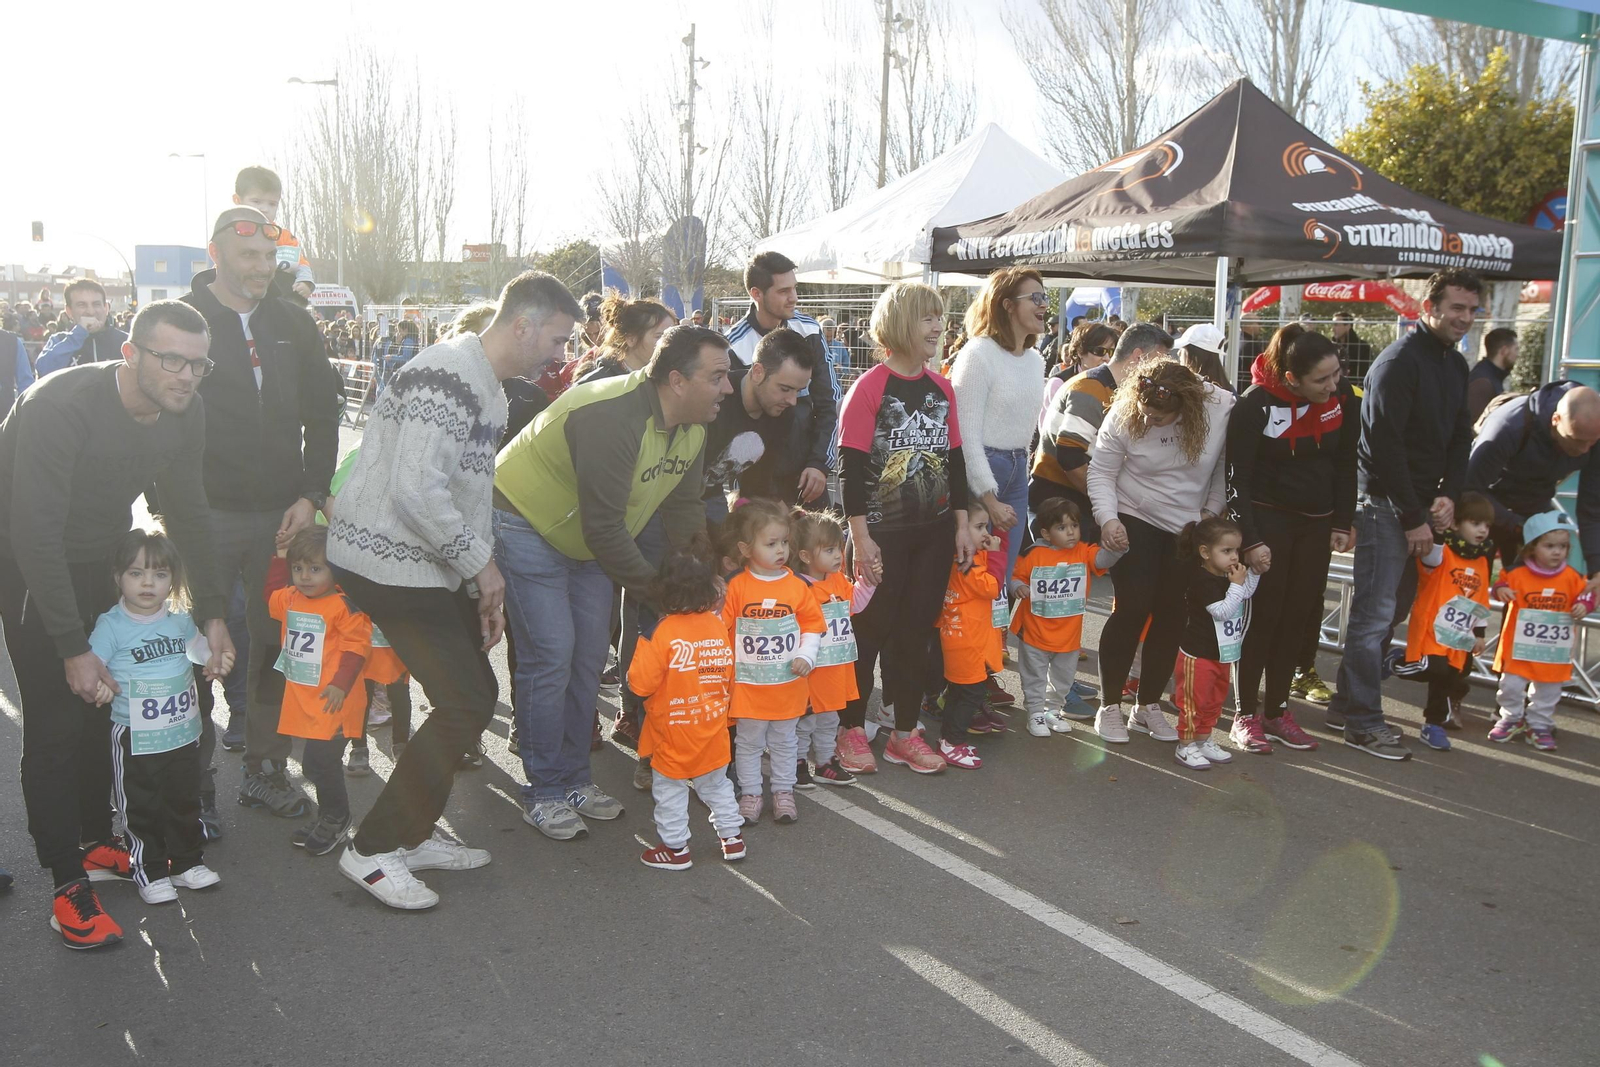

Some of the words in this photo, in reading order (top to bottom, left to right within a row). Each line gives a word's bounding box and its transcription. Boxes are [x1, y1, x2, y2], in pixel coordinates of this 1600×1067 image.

[956, 220, 1175, 261] www.cruzandolameta.es
[1343, 222, 1514, 260] cruzandolameta
[1398, 251, 1465, 268] cronometraje
[1466, 256, 1513, 272] deportivo
[895, 437, 944, 447] ESPARTO
[1160, 435, 1181, 443] WIT
[1037, 576, 1081, 594] 8427
[750, 608, 788, 618] SUPER
[1523, 622, 1570, 641] 8233
[288, 630, 316, 653] 72
[699, 638, 725, 648] MEDIO
[742, 632, 796, 655] 8230
[699, 646, 732, 657] MARATÓ
[142, 685, 197, 720] 8499
[168, 713, 187, 725] AROA
